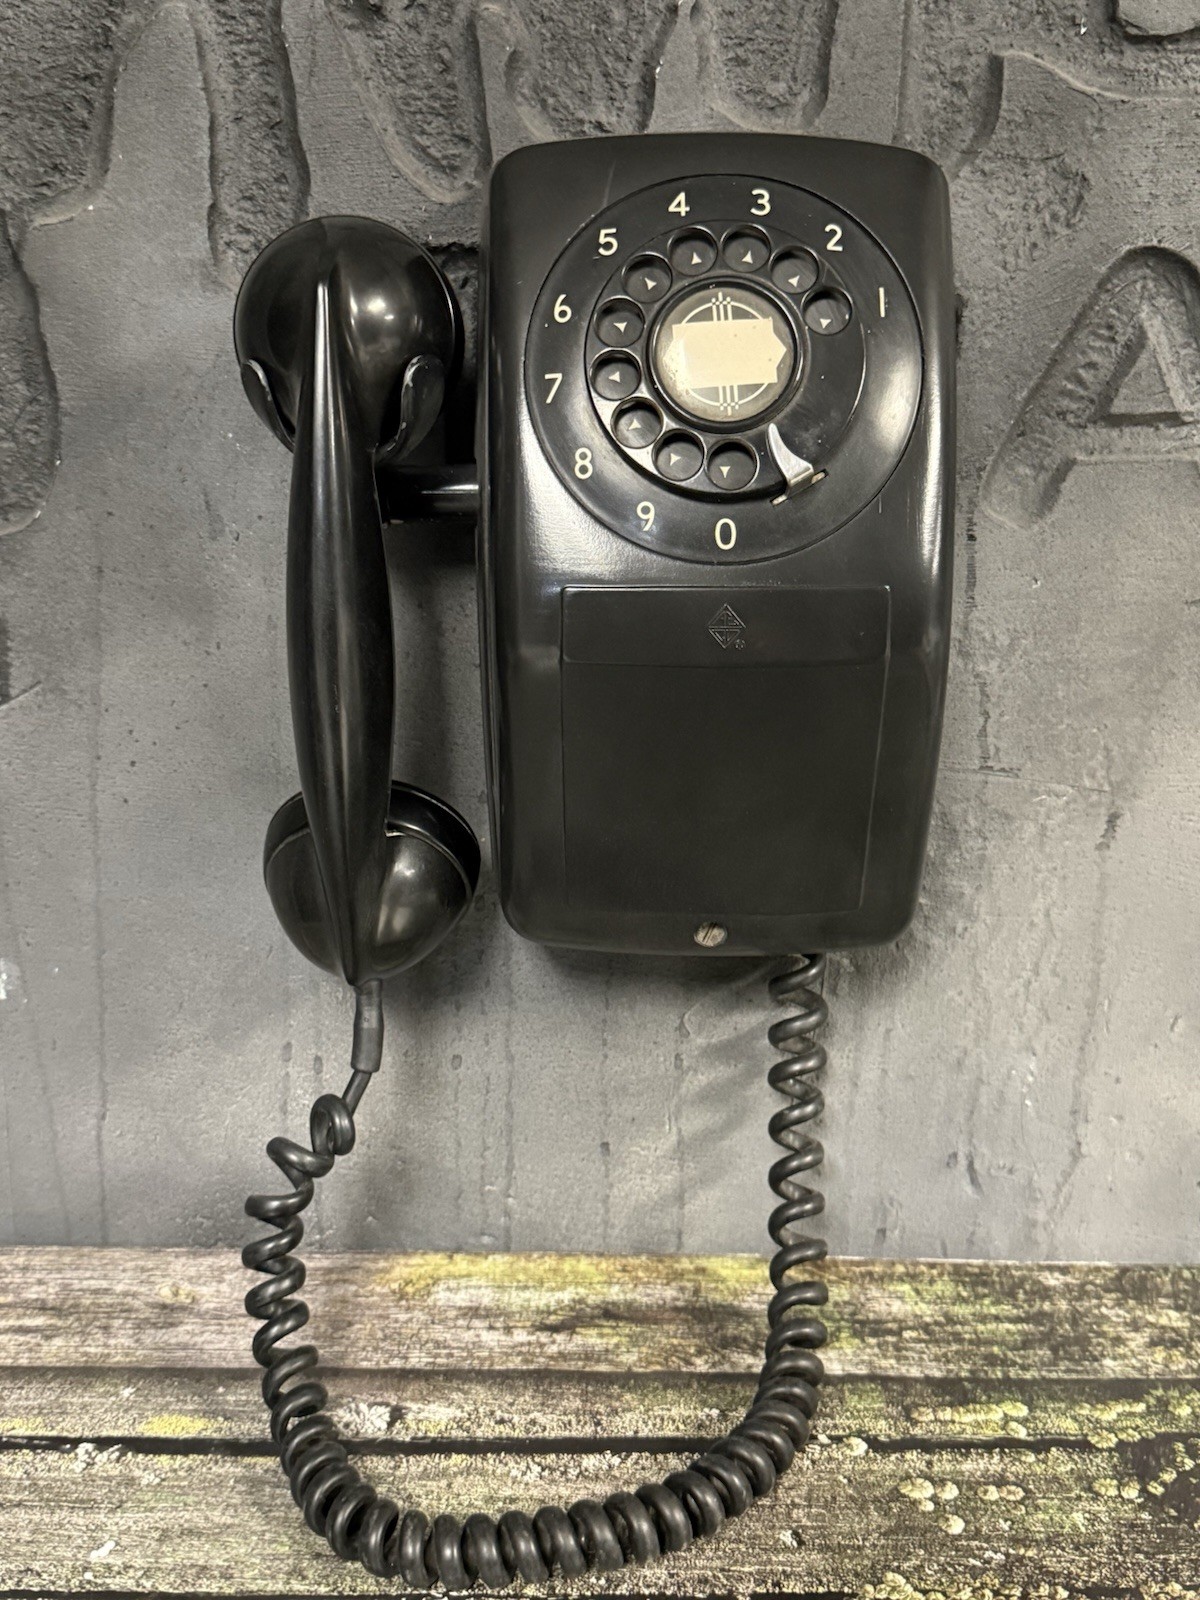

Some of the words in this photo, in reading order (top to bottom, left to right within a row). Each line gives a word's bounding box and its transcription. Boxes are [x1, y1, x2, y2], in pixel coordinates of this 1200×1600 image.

[667, 191, 691, 217] 4
[750, 188, 771, 216] 3
[597, 227, 619, 256] 5
[825, 223, 844, 252] 2
[552, 293, 573, 324] 6
[878, 286, 886, 318] 1
[544, 372, 563, 404] 7
[574, 446, 593, 480] 8
[636, 501, 656, 533] 9
[714, 518, 737, 551] 0
